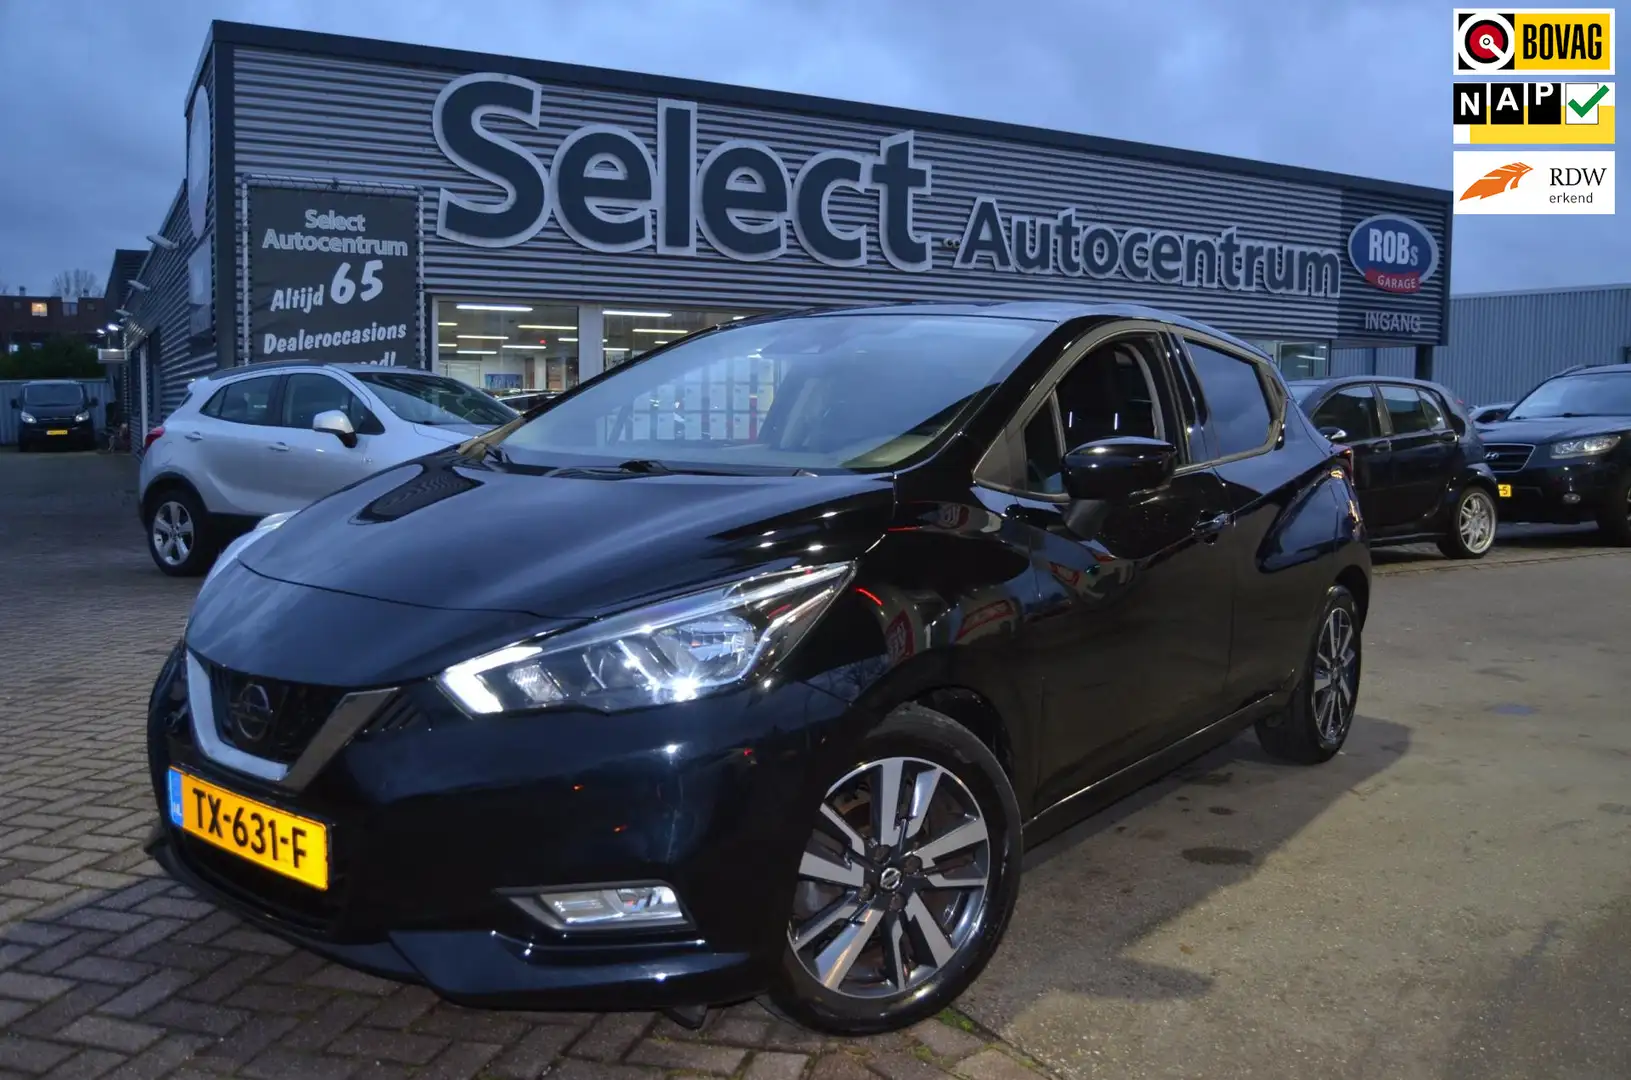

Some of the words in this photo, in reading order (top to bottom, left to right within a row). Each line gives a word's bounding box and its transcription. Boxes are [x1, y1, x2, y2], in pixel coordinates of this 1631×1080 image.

[432, 72, 932, 273] Select
[953, 196, 1341, 299] Autocentrum
[304, 209, 366, 232] Select
[262, 228, 408, 257] Autocentrum
[1368, 228, 1419, 267] ROBs
[270, 283, 325, 314] Altijd
[330, 260, 384, 305] 65
[1377, 275, 1417, 289] GARAGE
[263, 322, 408, 355] Dealeroccasions
[1364, 311, 1422, 333] INGANG
[192, 786, 308, 869] TX-631-F
